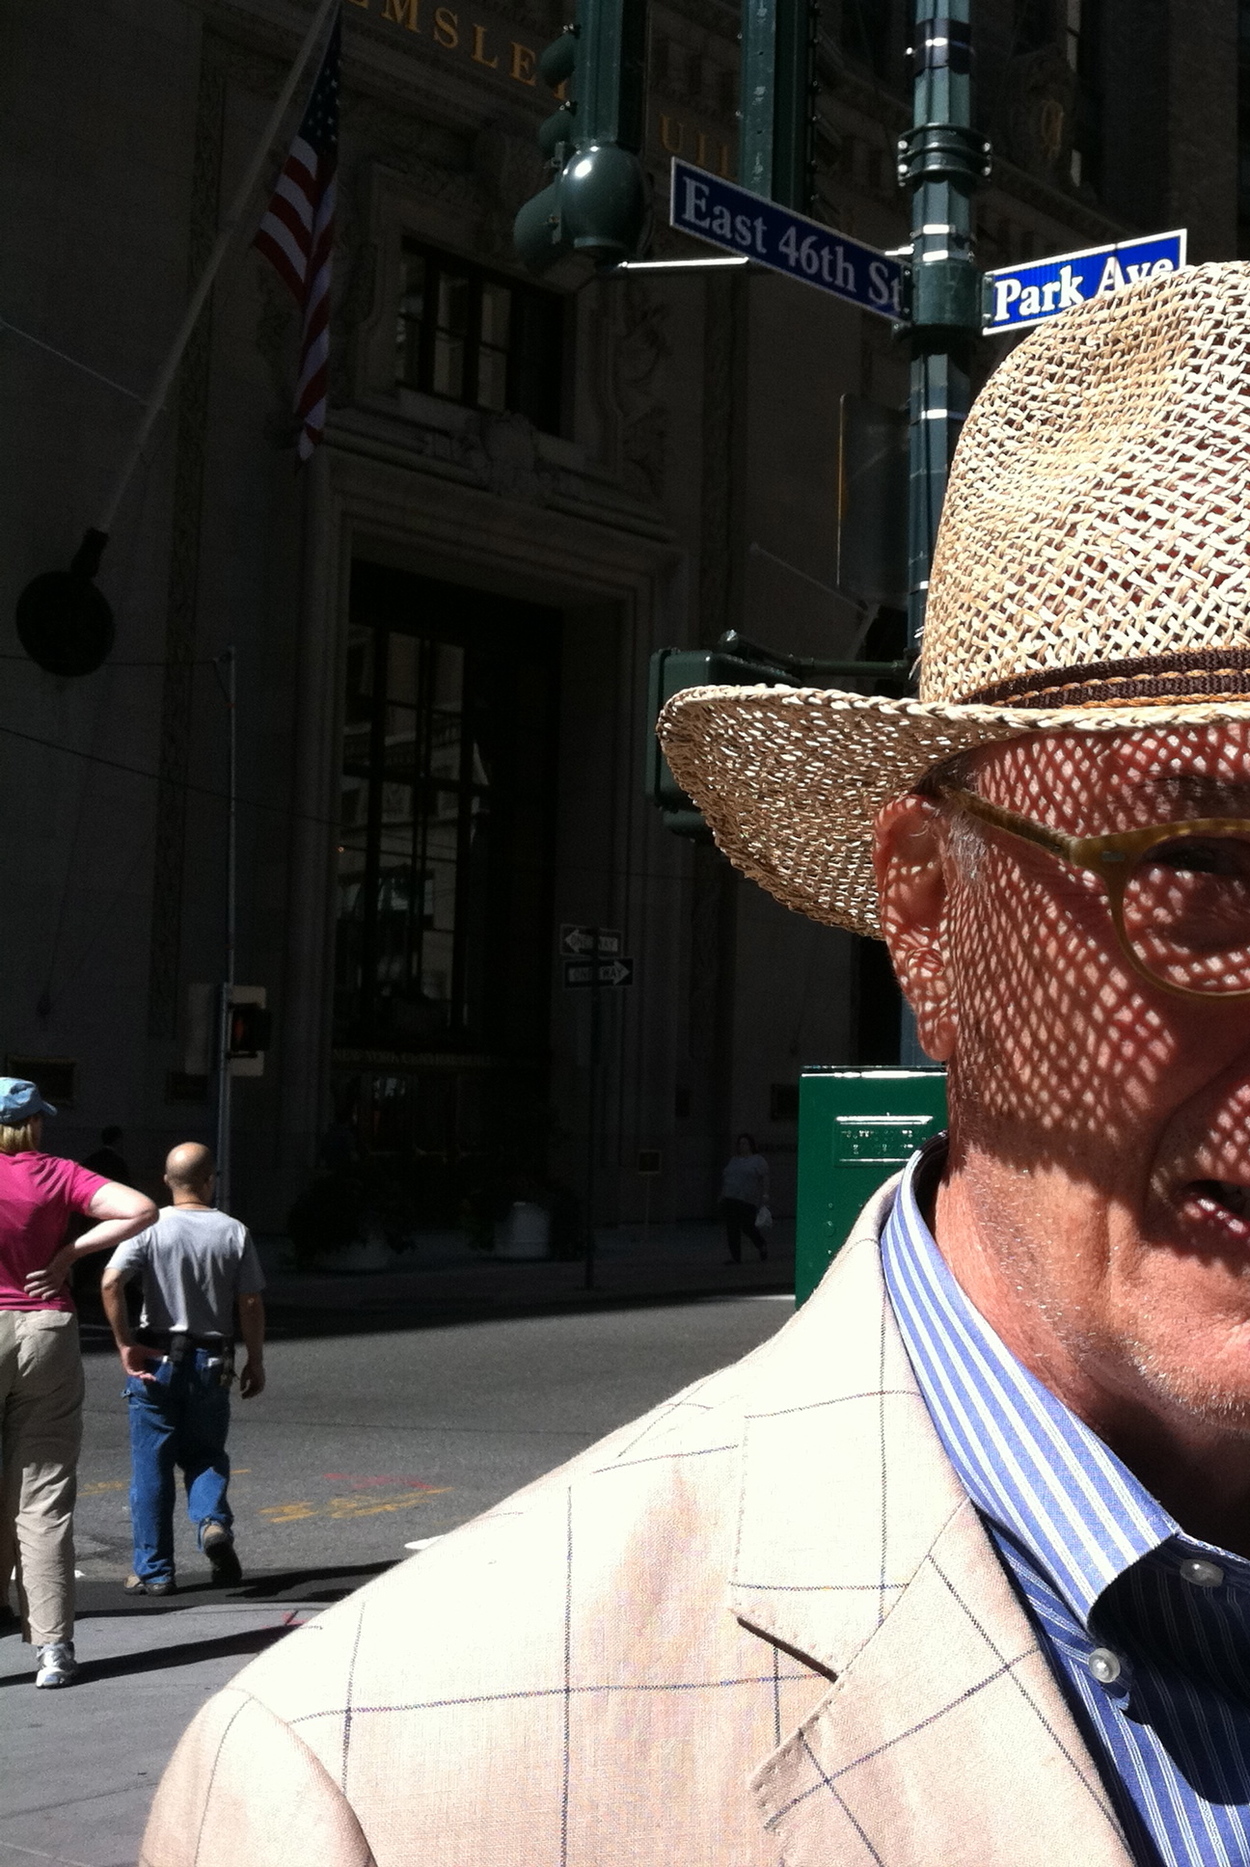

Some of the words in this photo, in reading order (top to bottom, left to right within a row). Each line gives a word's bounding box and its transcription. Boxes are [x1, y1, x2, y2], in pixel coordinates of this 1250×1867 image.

[347, 0, 567, 101] MSLE
[682, 176, 768, 254] East
[778, 226, 857, 293] 46th
[868, 261, 903, 312] St
[994, 264, 1085, 321] Park
